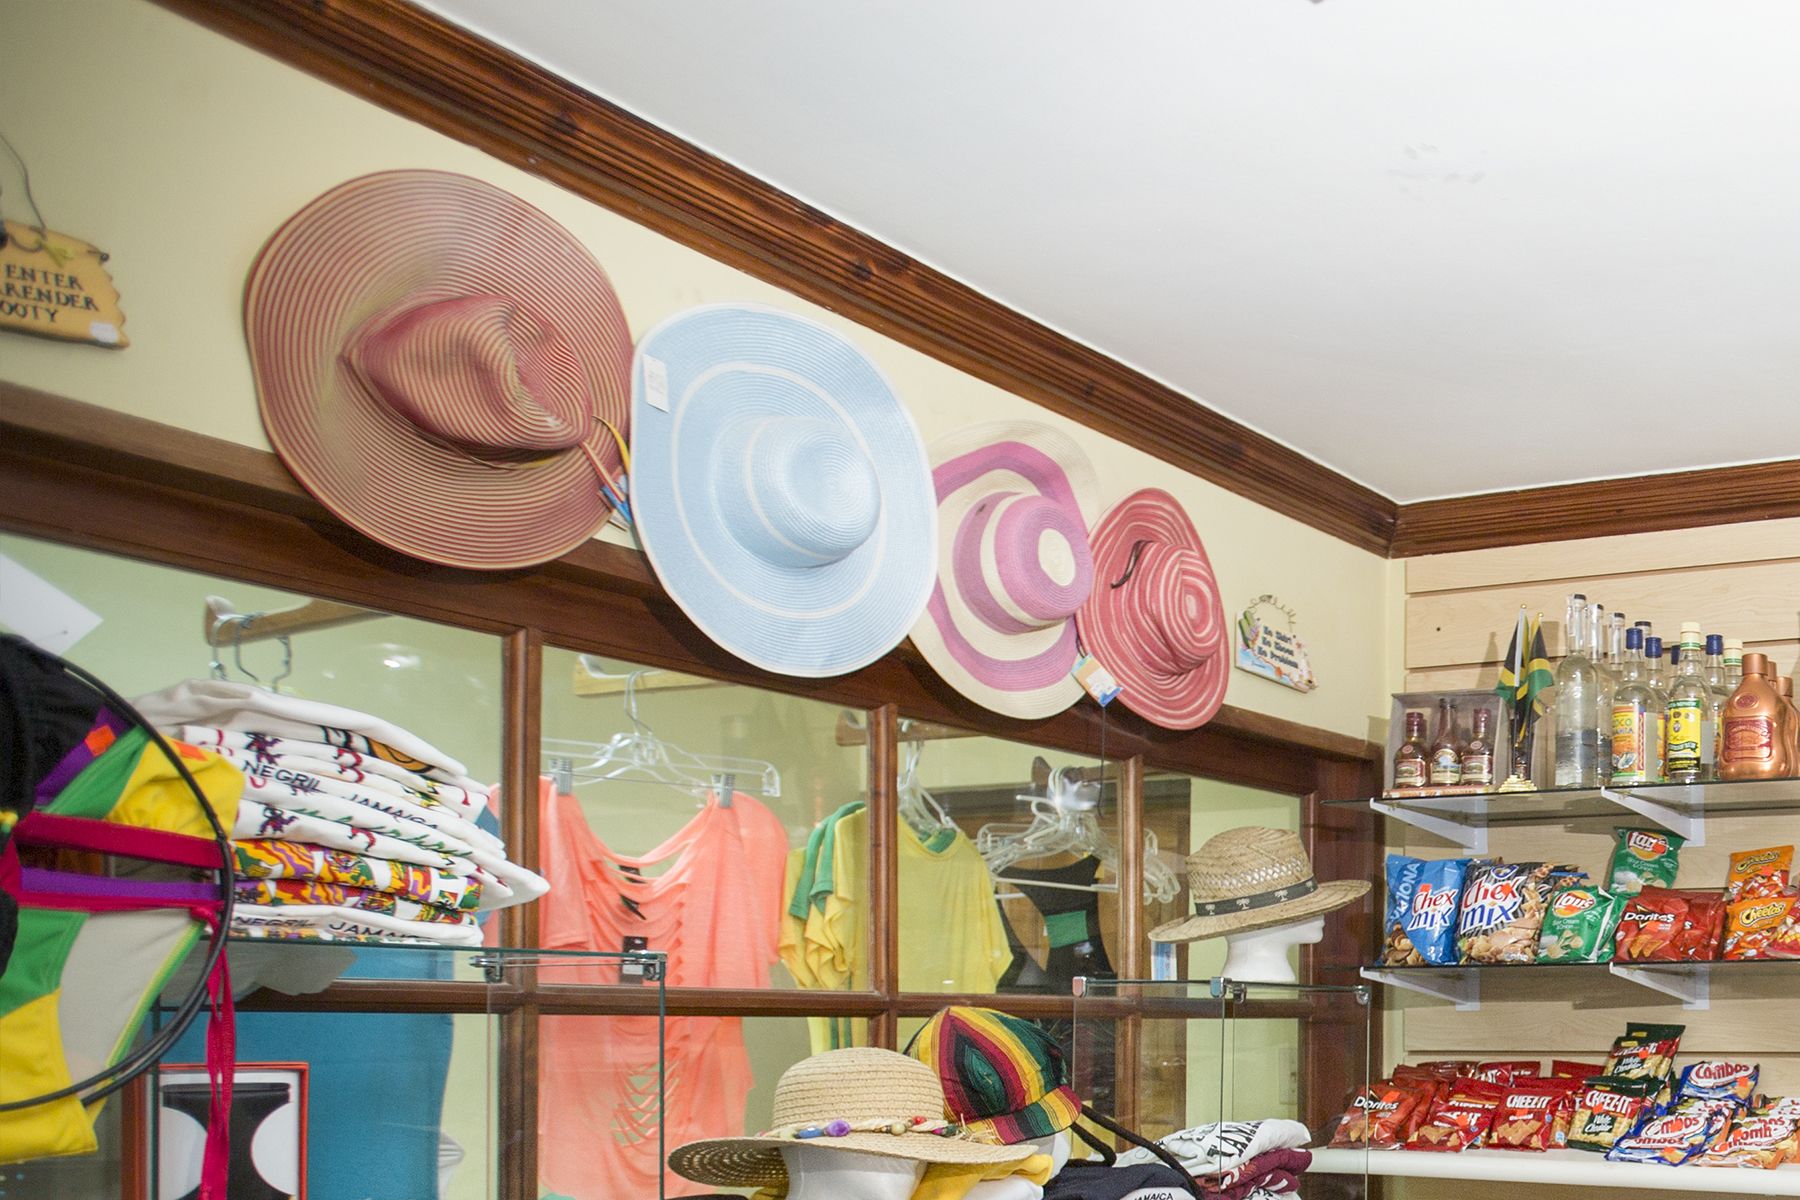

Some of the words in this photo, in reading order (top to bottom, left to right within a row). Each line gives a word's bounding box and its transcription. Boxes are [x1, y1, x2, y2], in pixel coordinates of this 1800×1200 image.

[4, 263, 84, 291] ENTER
[0, 281, 100, 312] RENDER
[1624, 911, 1675, 922] Doritos
[1740, 902, 1786, 926] Cheetos
[1353, 1095, 1400, 1110] Doritos
